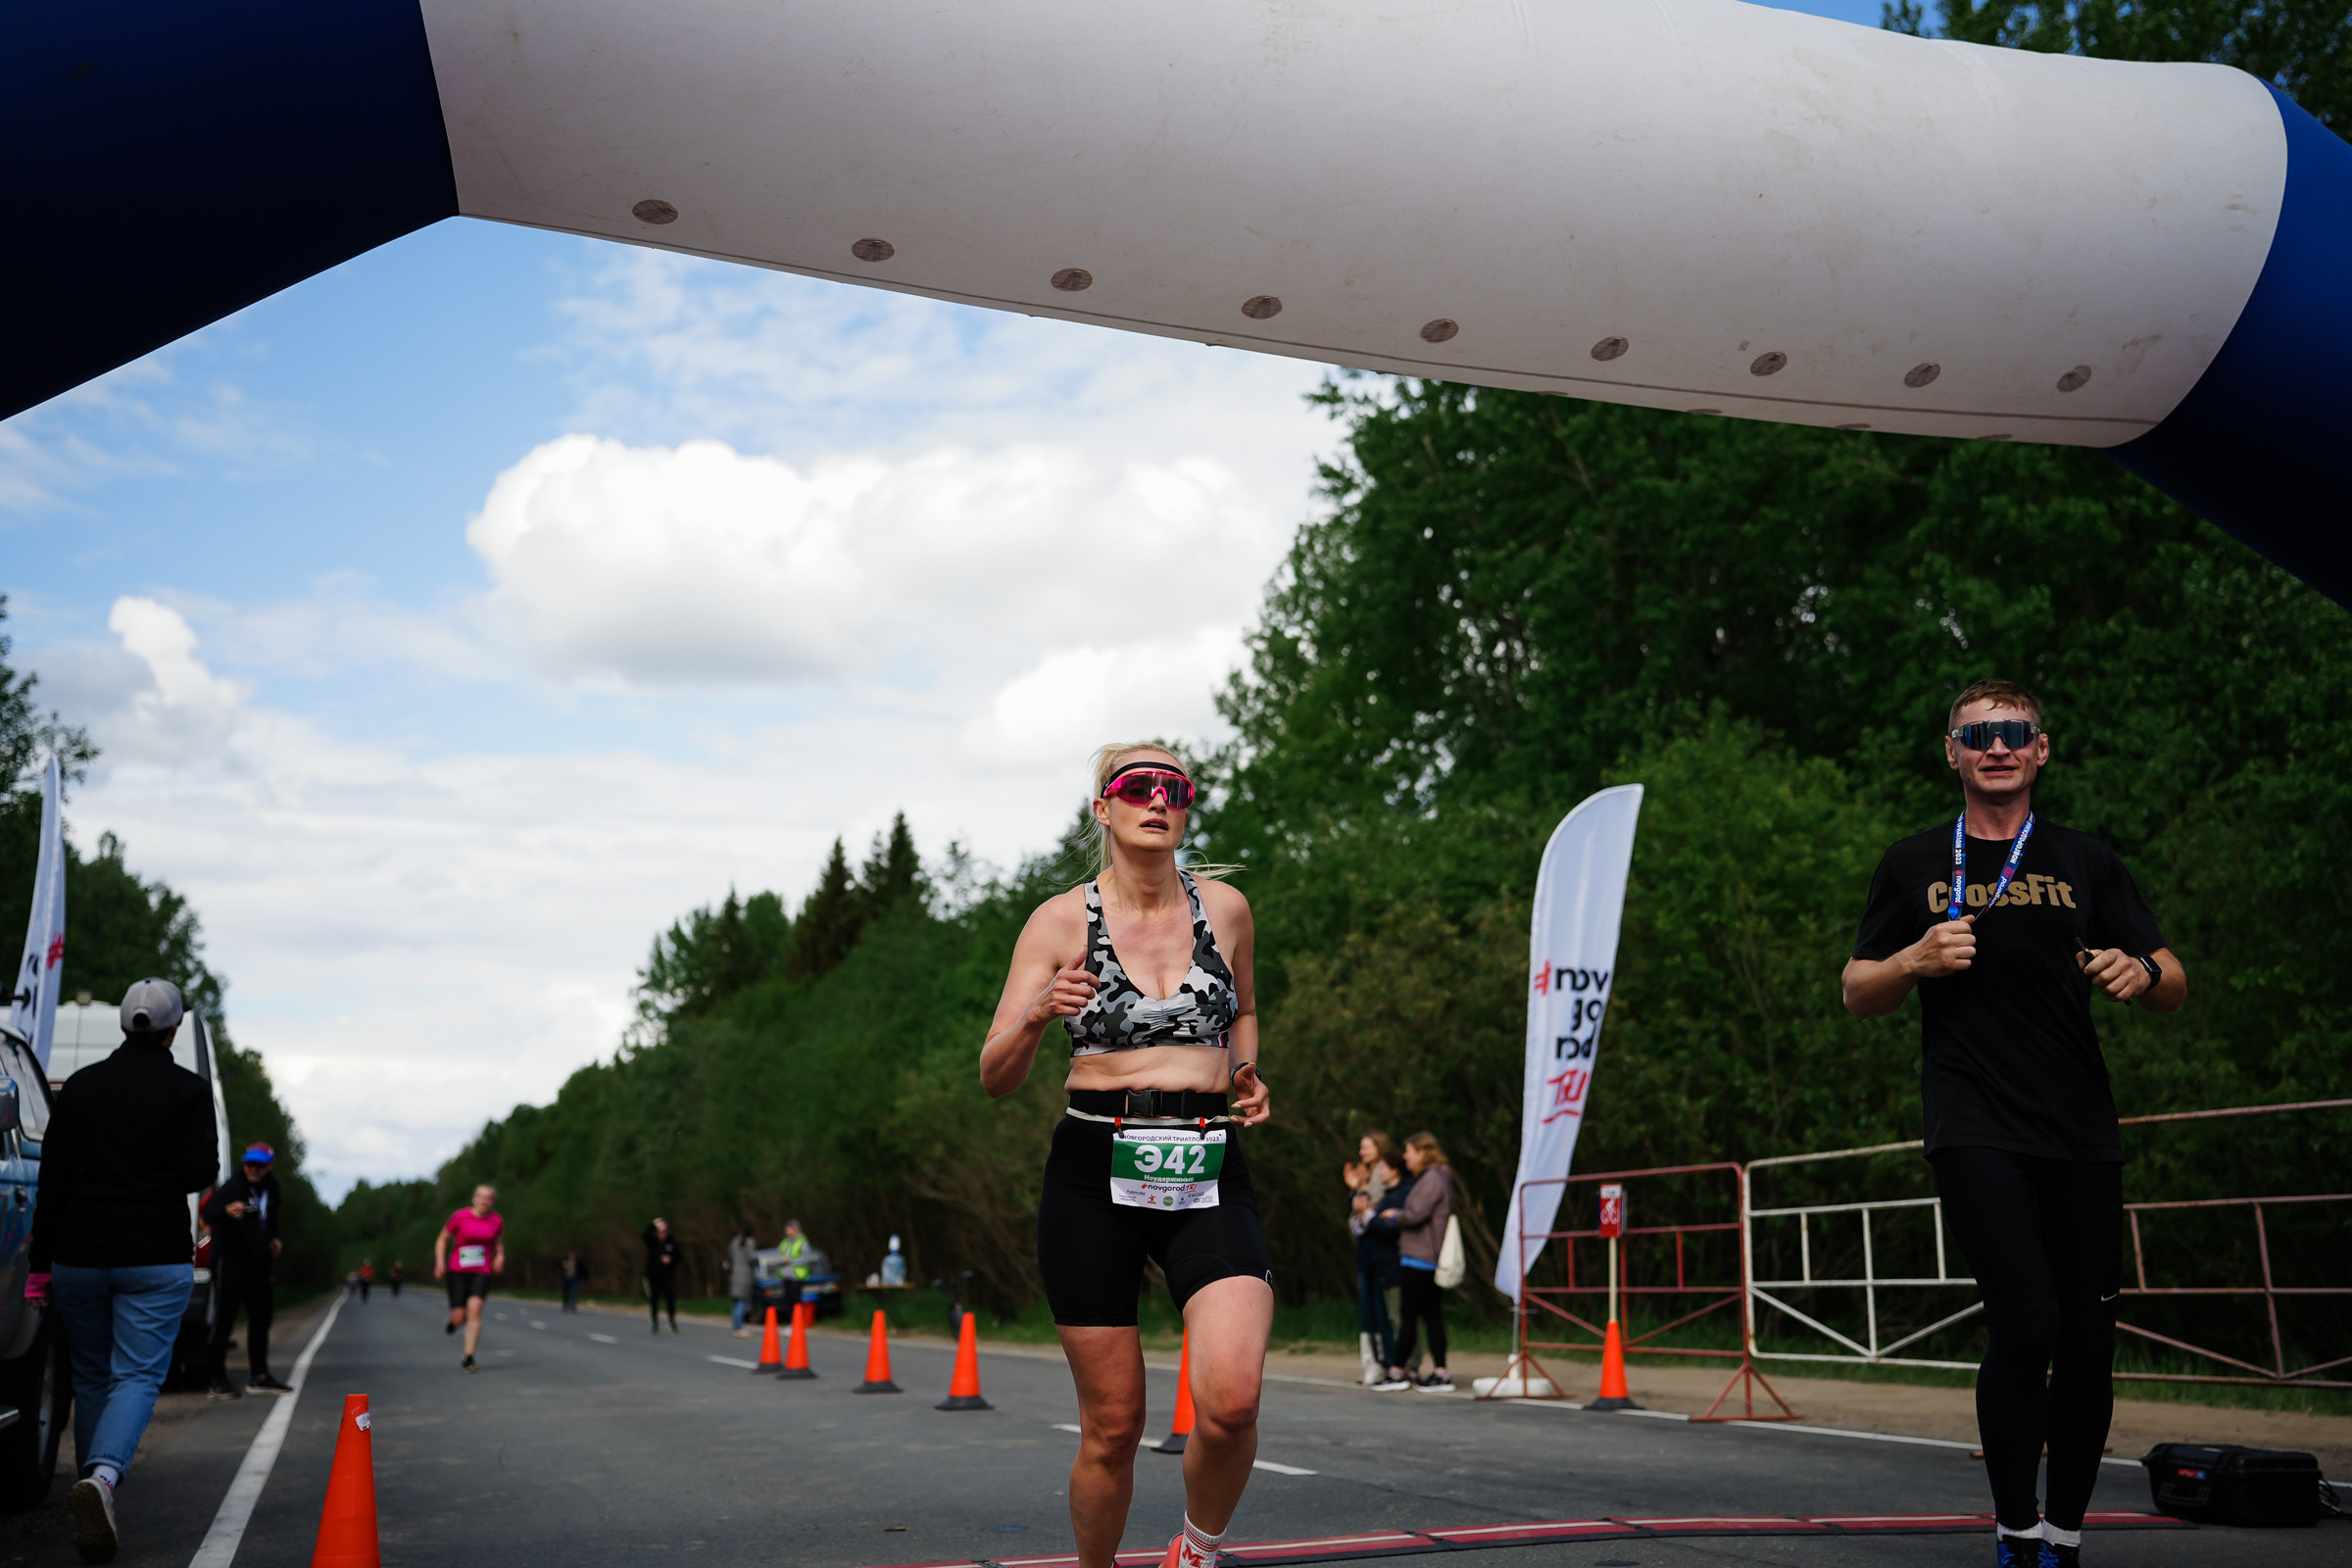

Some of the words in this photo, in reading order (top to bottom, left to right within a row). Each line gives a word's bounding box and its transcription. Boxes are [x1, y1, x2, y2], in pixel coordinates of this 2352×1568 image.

[2009, 820, 2033, 864] НОВГОРОДСКИЙ
[1927, 873, 2077, 913] CossFit
[1134, 1145, 1206, 1175] Э42
